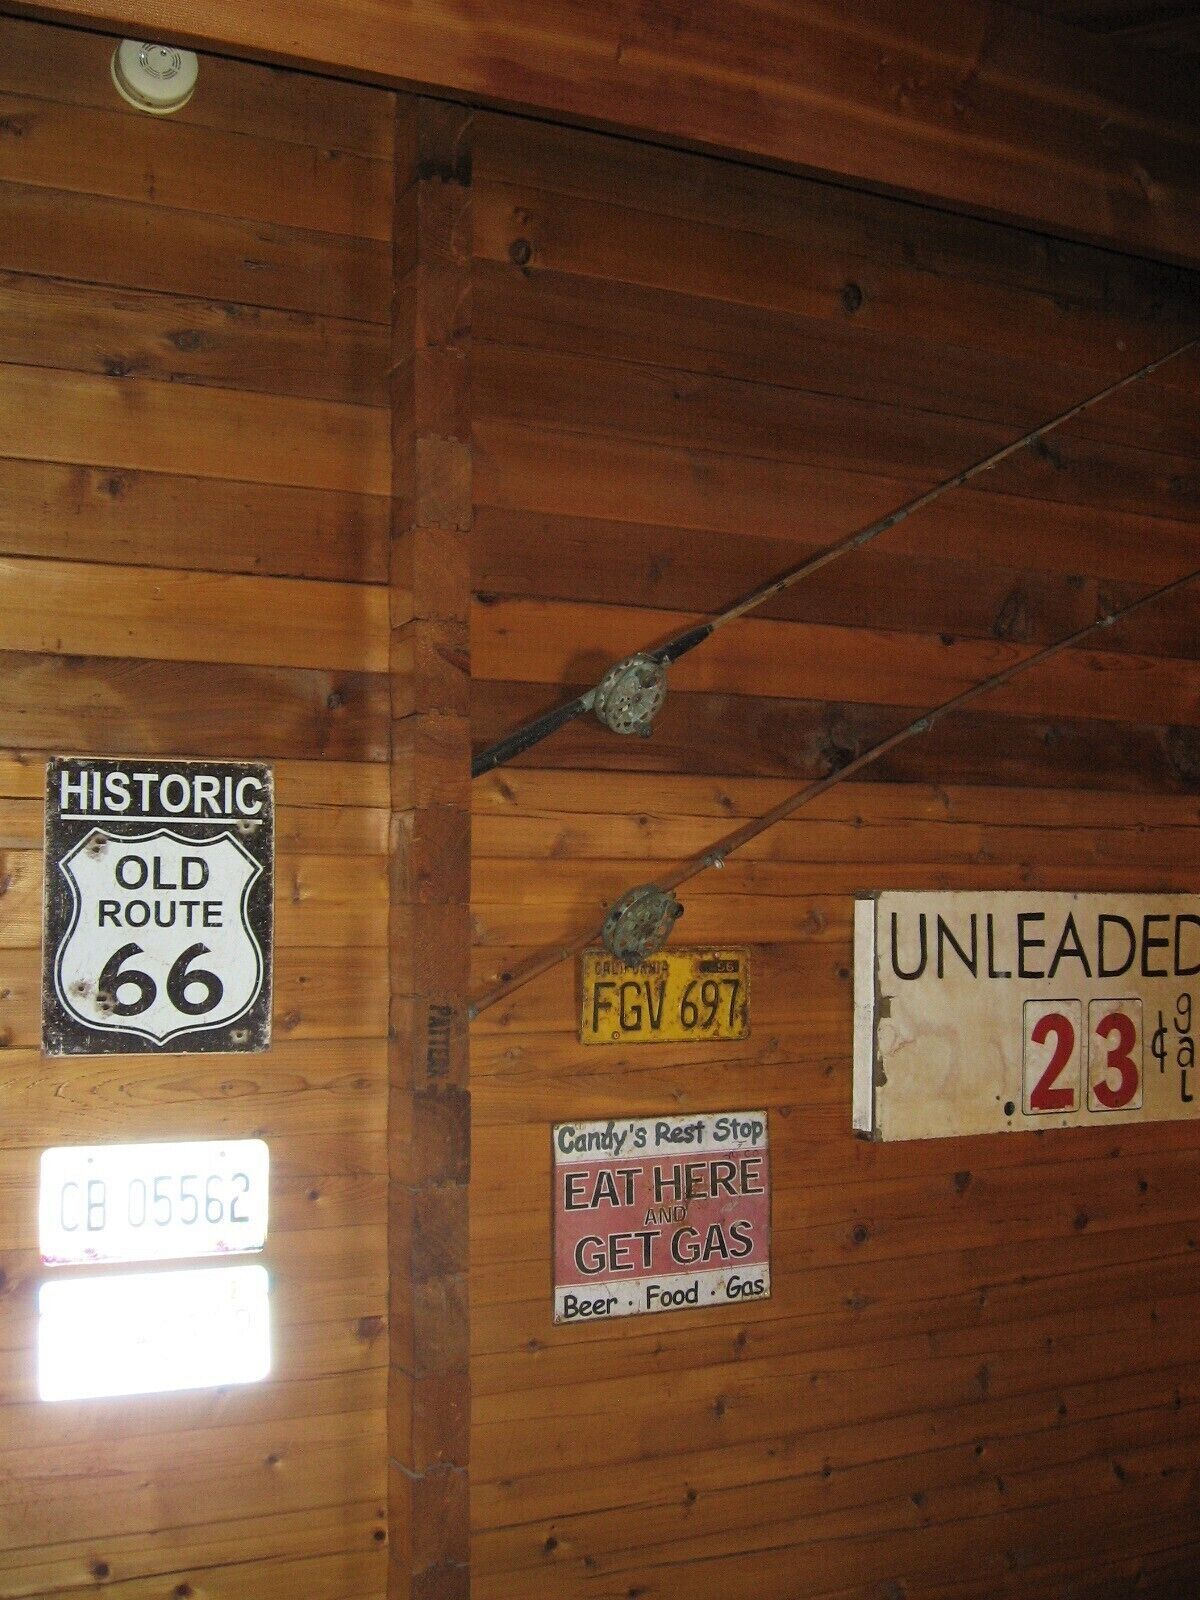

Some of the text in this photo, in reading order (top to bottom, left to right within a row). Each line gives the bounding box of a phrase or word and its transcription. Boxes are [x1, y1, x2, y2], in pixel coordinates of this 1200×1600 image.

[60, 770, 263, 815] HISTORIC
[115, 855, 210, 890] OLD
[98, 900, 223, 928] ROUTE
[891, 911, 1200, 980] UNLEADED
[98, 942, 224, 1016] 66
[592, 977, 740, 1033] FGV 697
[1030, 1012, 1139, 1110] 23
[557, 1117, 764, 1156] Candy's Rest Stop
[60, 1172, 250, 1232] CB 05562
[564, 1157, 764, 1212] EAT HERE
[644, 1205, 687, 1226] AND
[574, 1220, 754, 1276] GET GAS
[563, 1275, 764, 1319] Beer Food Gas
